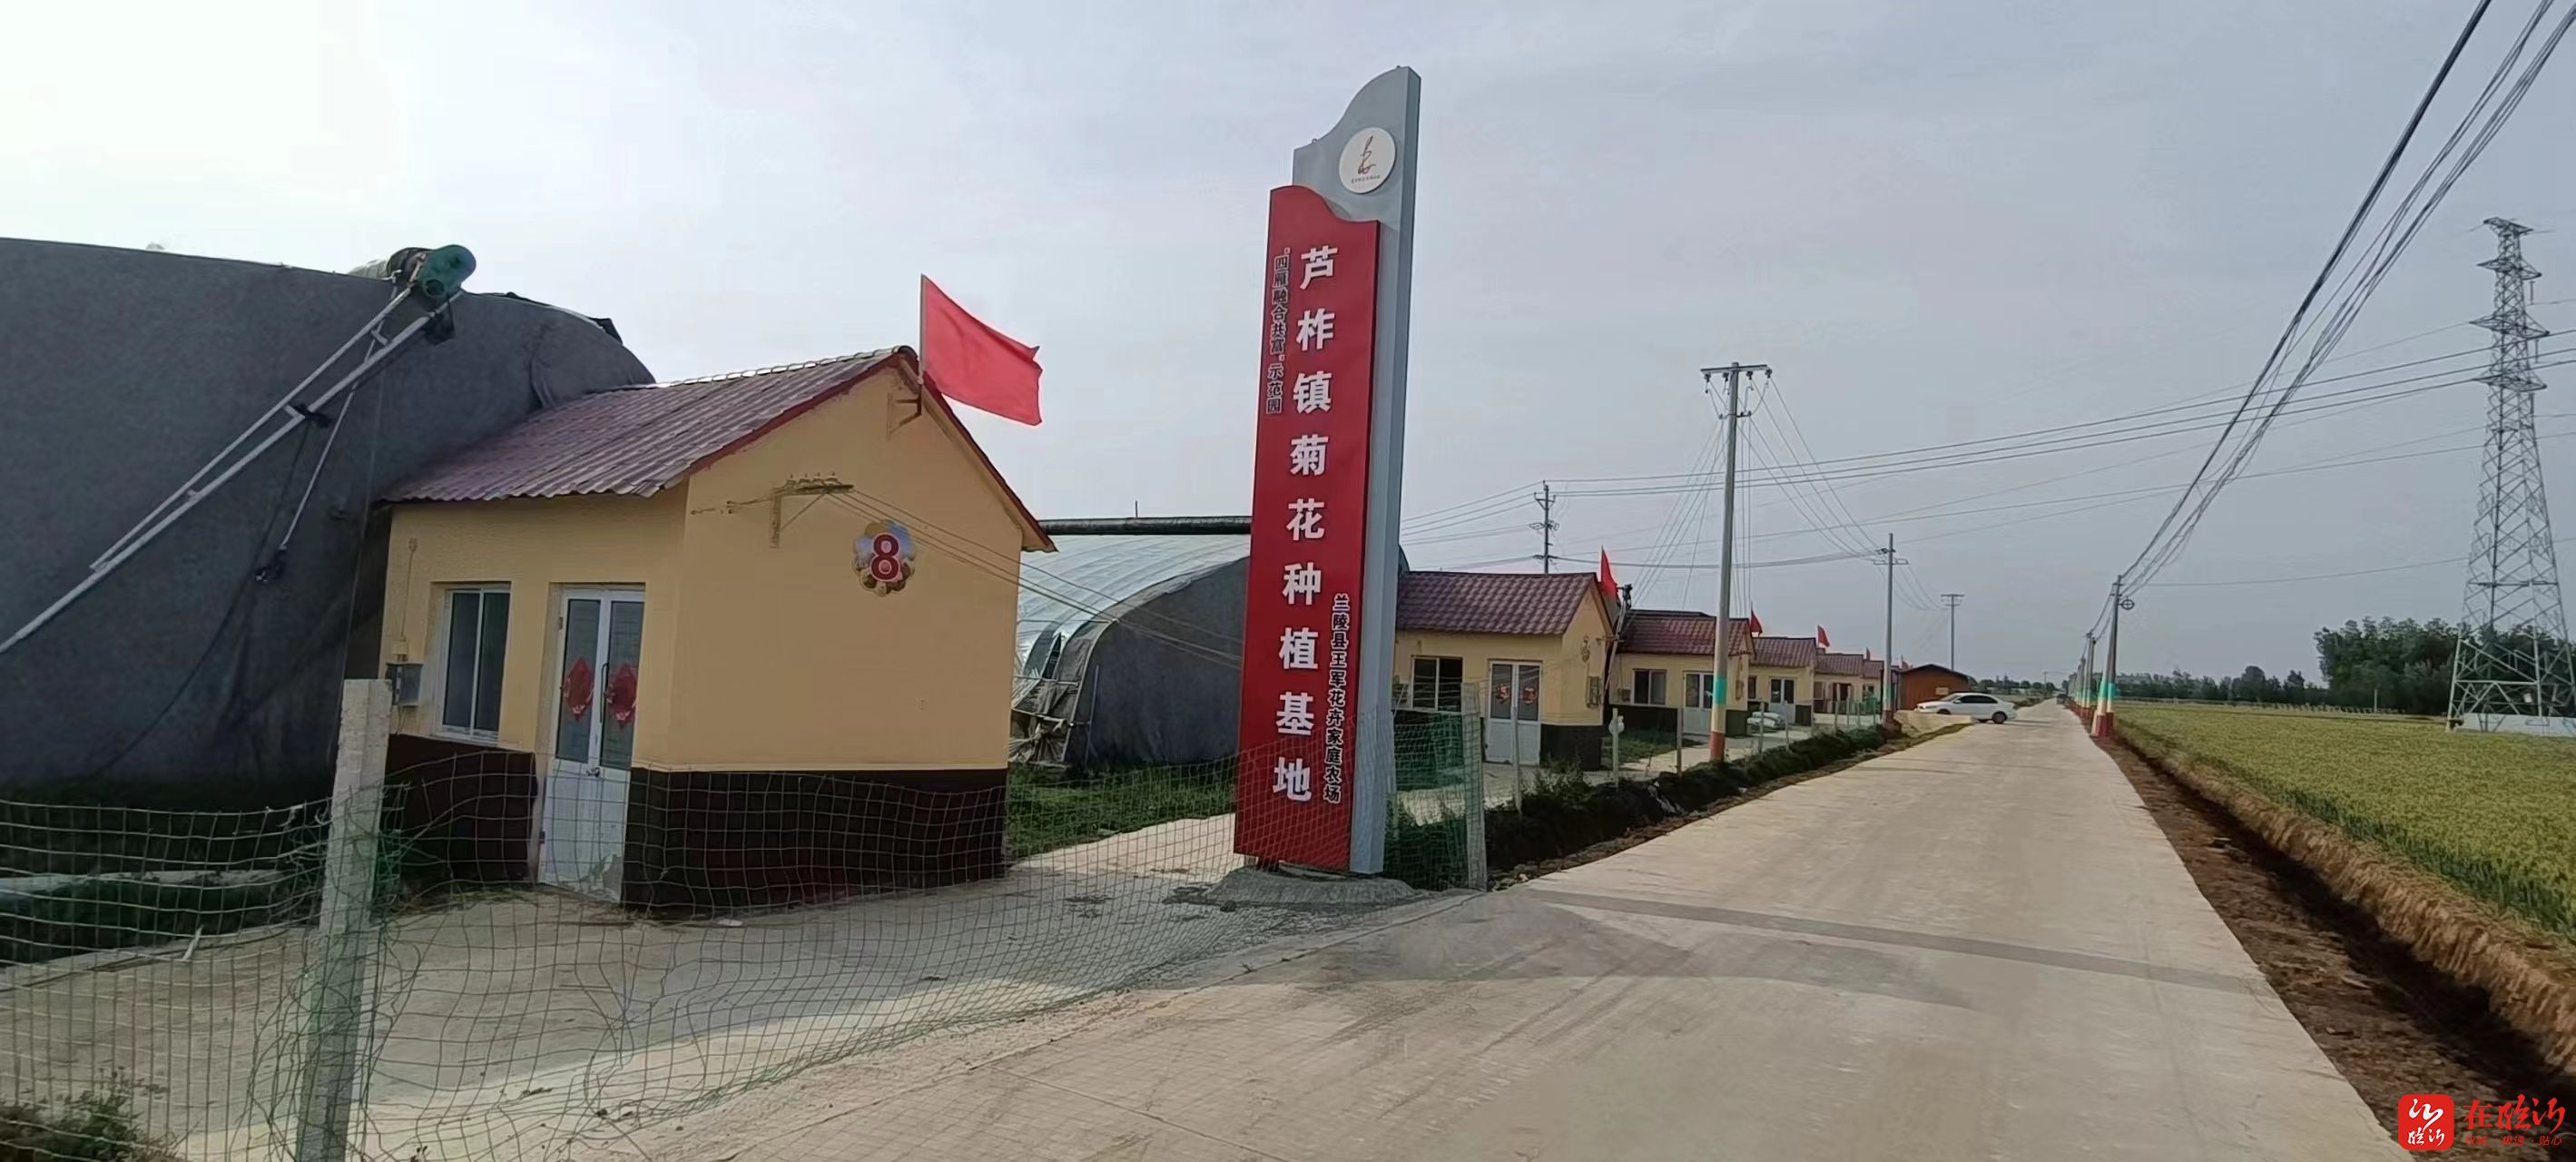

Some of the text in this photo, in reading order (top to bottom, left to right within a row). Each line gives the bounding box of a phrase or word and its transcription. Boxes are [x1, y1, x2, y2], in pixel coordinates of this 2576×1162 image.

[871, 532, 900, 582] 8
[1273, 246, 1338, 803] 芦柞镇菊花种植基地
[1323, 593, 1350, 804] 兰陵县王军花卉家庭农场
